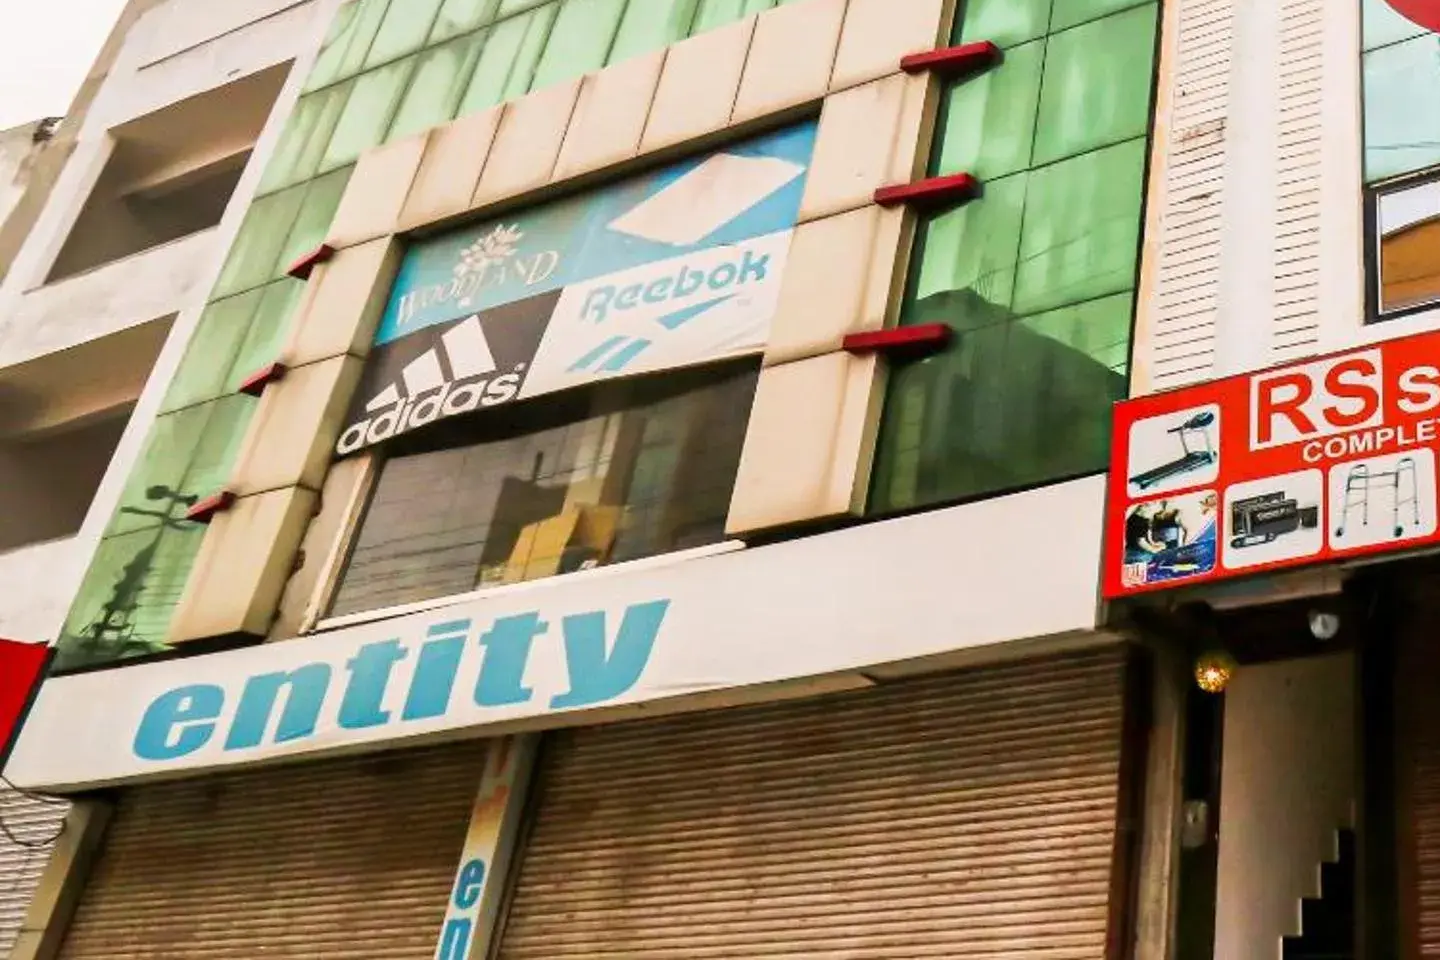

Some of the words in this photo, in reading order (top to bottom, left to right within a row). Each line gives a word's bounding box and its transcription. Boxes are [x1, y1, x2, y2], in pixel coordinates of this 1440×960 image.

[580, 250, 771, 324] Reebok
[336, 373, 521, 455] adidas
[1256, 356, 1381, 447] RS
[132, 598, 672, 762] entity
